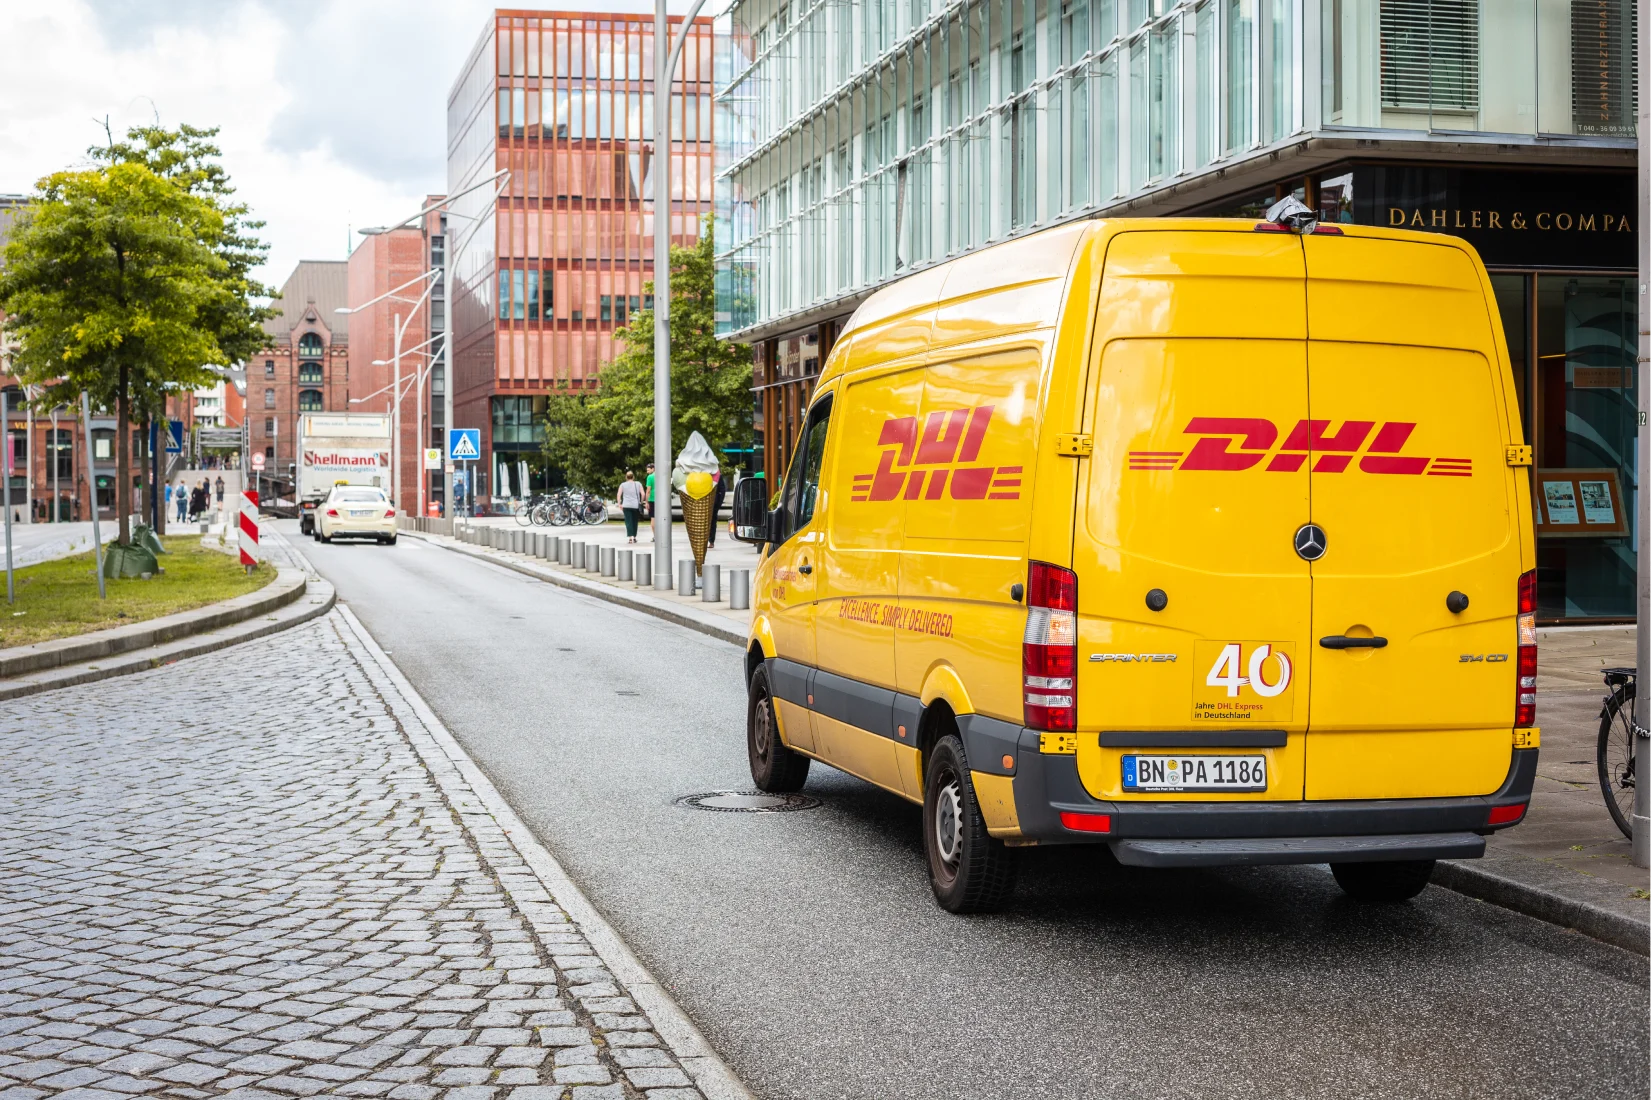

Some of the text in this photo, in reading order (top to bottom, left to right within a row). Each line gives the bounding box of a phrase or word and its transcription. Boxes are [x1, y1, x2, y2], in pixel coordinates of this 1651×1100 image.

[1388, 207, 1503, 230] DAHLER
[1535, 212, 1638, 233] COMPA
[868, 405, 996, 502] DHL
[1178, 417, 1432, 475] DHL
[880, 604, 909, 629] SIMPLY
[908, 608, 954, 639] DELIVERED.
[1088, 653, 1178, 663] SPRINTER
[1206, 643, 1293, 698] 40
[1485, 653, 1509, 663] CDI
[1194, 711, 1251, 719] in Deutschland
[1195, 702, 1263, 712] Jahre DHL Express
[1138, 759, 1263, 784] BN PA 1186
